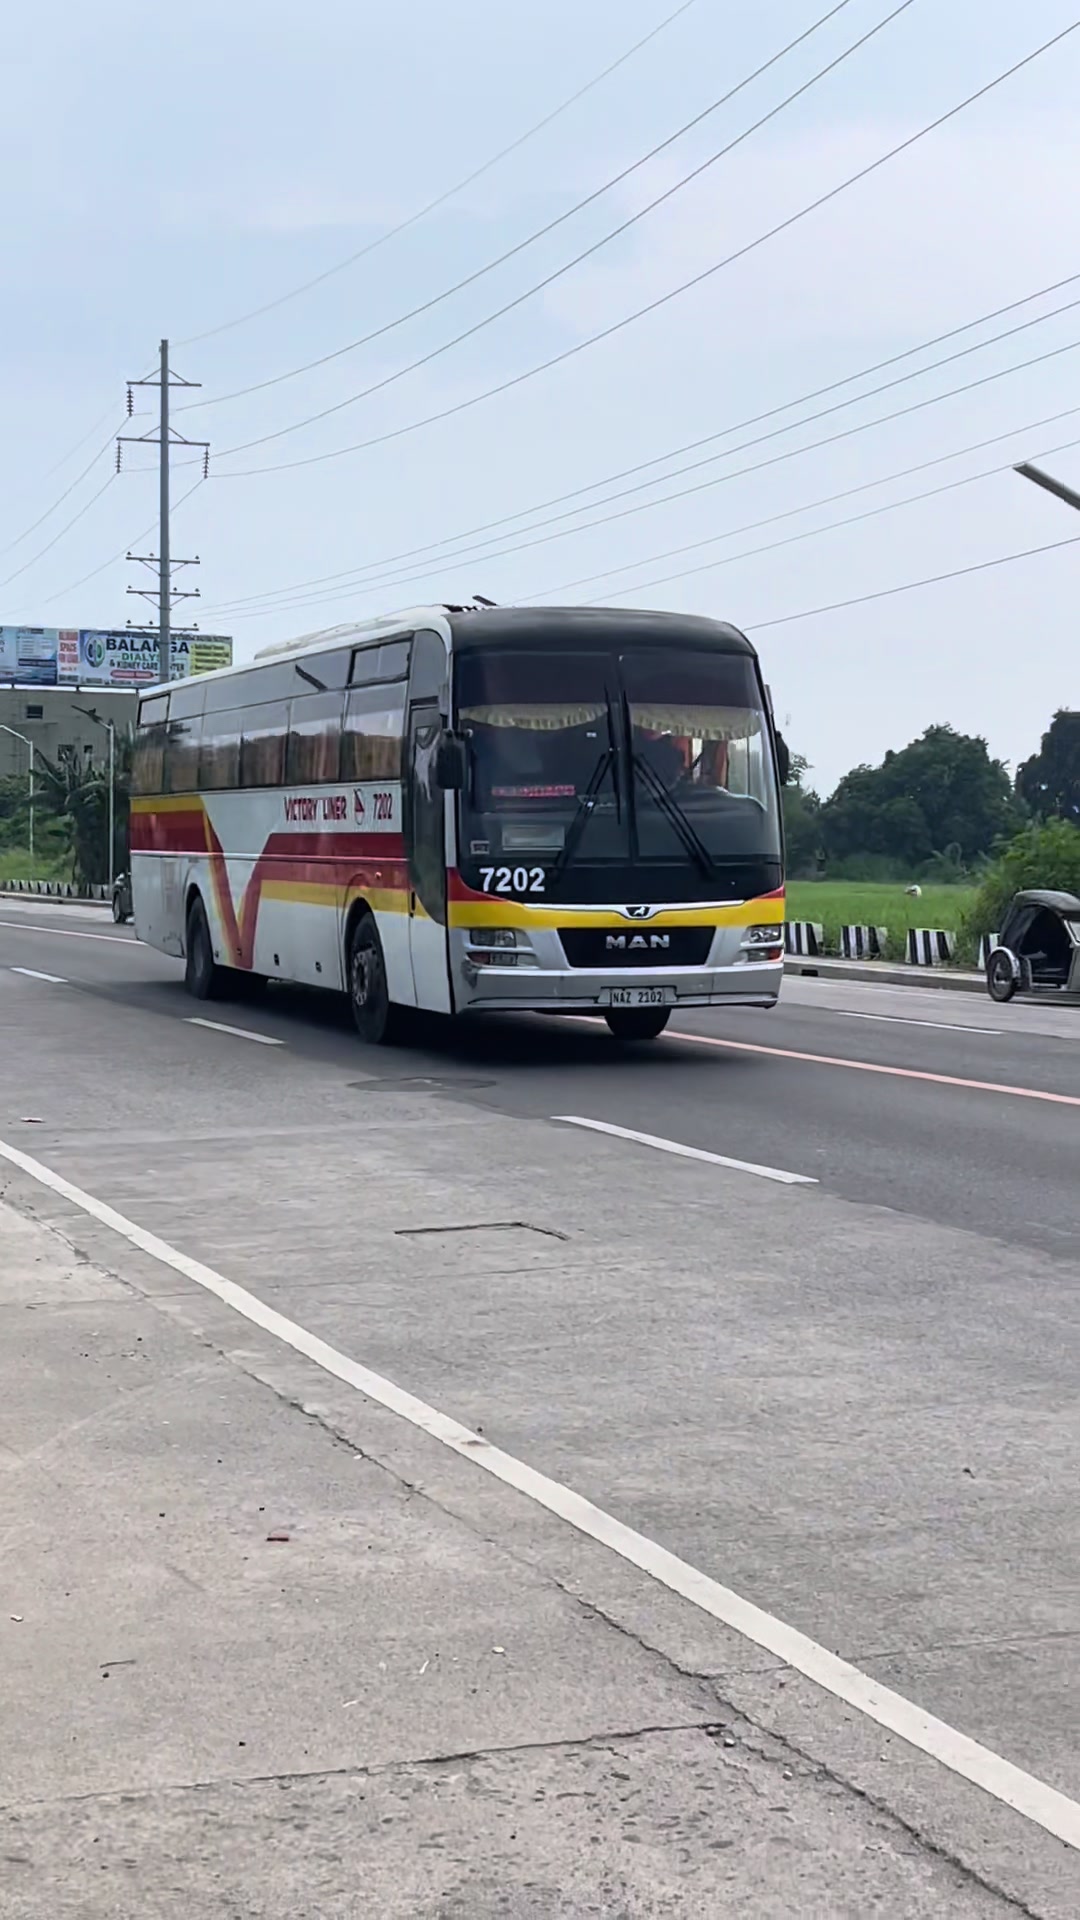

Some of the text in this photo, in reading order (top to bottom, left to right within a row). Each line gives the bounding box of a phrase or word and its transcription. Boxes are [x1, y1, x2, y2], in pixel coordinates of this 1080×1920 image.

[109, 659, 115, 667] &
[117, 661, 140, 670] KIDNEY
[142, 661, 158, 671] CARE
[284, 792, 393, 821] VICTORY LINER 7202
[479, 866, 546, 892] 7202
[605, 934, 670, 949] MAN
[613, 991, 663, 1004] NAZ 2102
